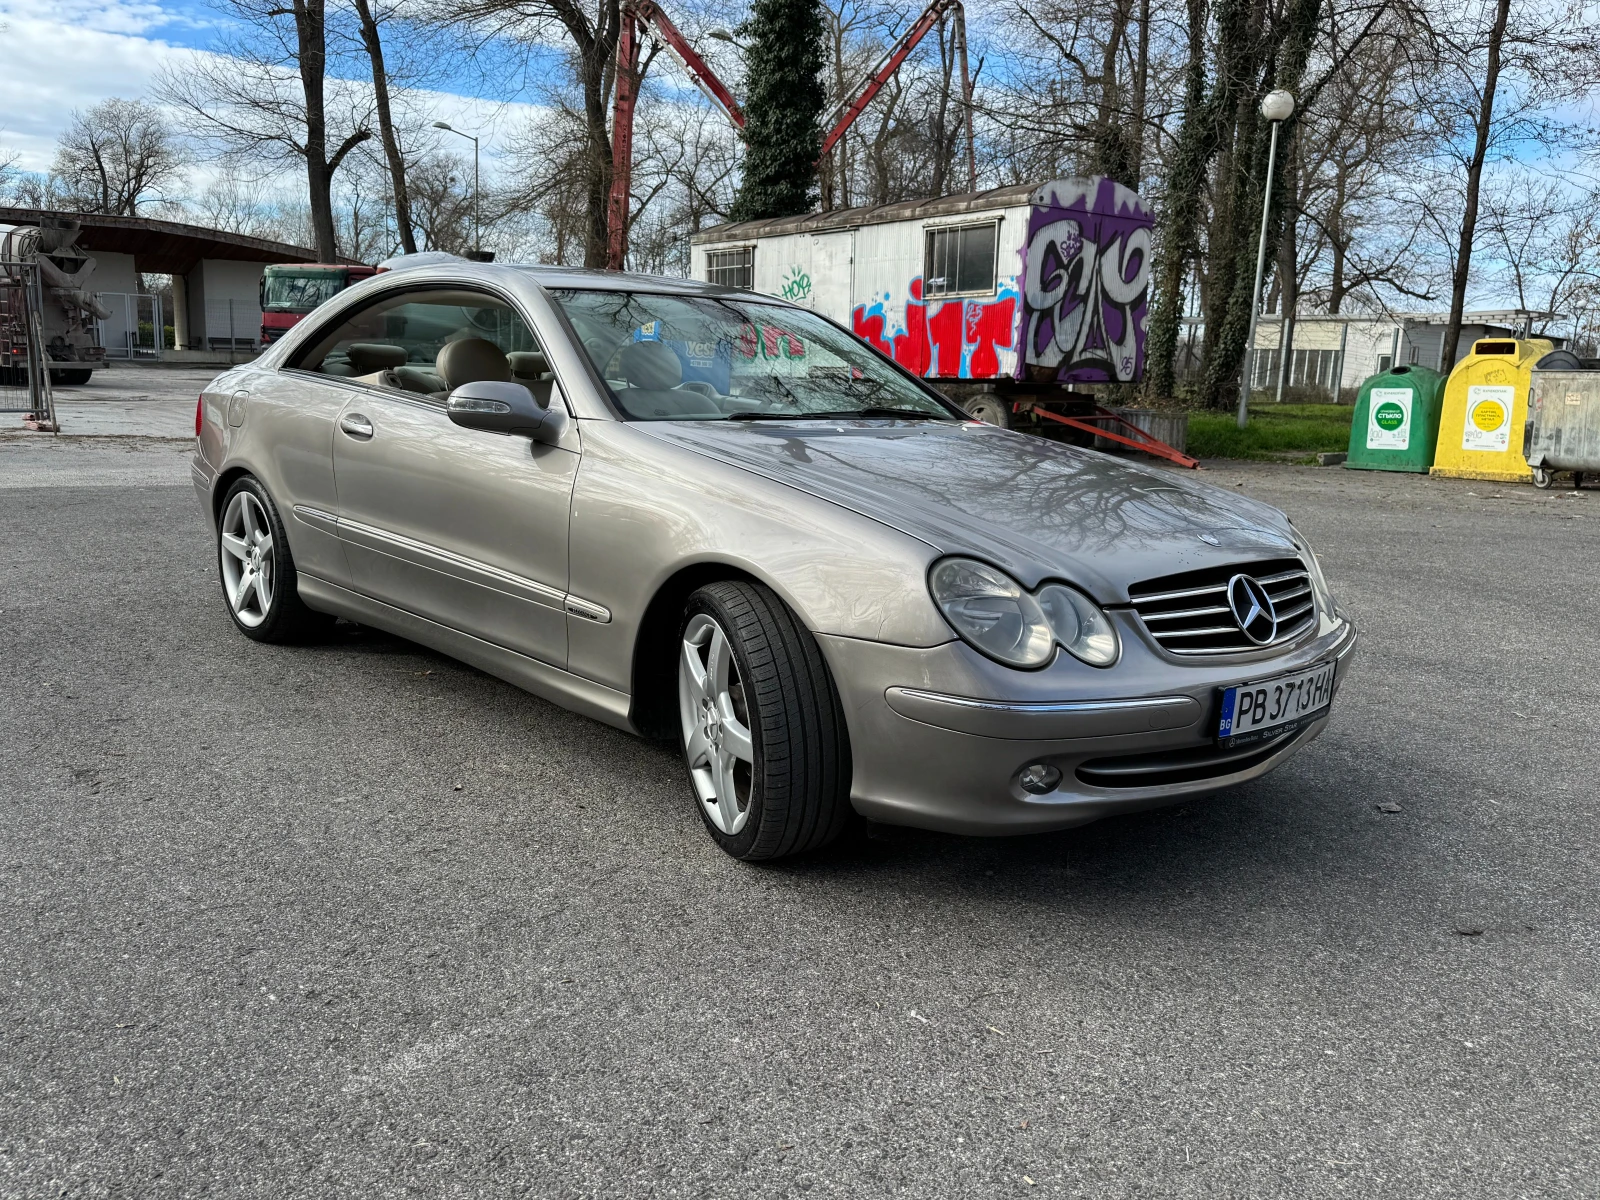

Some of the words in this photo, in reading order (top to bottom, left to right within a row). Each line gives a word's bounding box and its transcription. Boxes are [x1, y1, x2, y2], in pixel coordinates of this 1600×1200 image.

[1220, 718, 1232, 731] BG
[1262, 727, 1284, 739] SILVER
[1284, 722, 1299, 732] STAR
